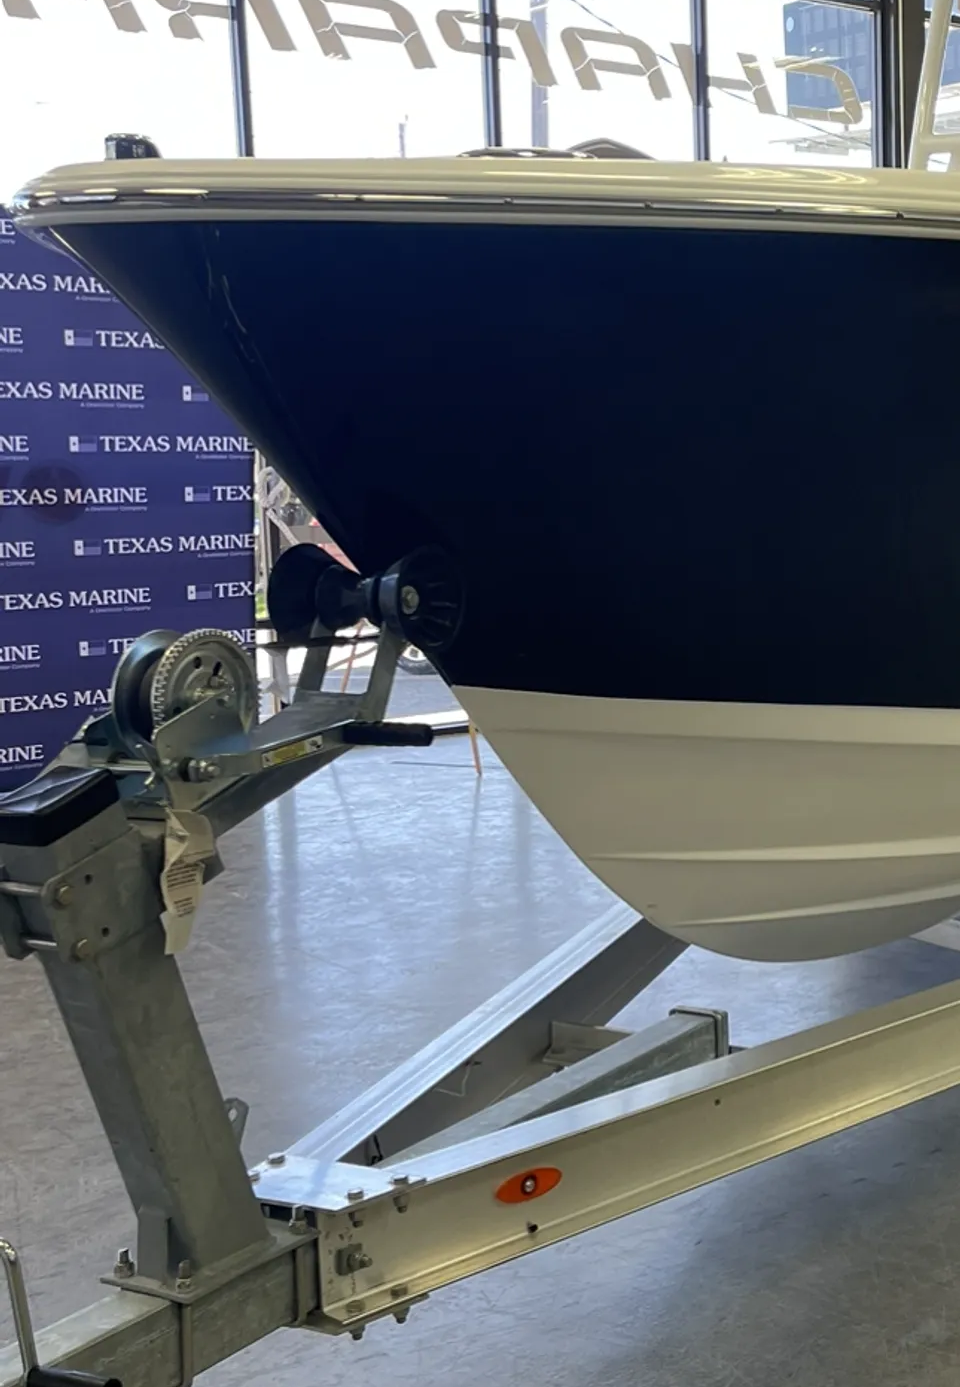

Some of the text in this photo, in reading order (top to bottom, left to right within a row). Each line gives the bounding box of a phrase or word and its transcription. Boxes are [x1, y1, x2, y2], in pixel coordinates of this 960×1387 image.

[0, 273, 111, 294] XAS MAR
[58, 382, 145, 401] MARINE
[99, 435, 255, 453] TEXAS MARINE
[63, 486, 148, 505] MARINE
[212, 485, 253, 502] TEX
[104, 536, 173, 555] TEXAS
[178, 532, 256, 552] MARINE
[68, 586, 152, 608] MARINE
[214, 580, 254, 599] TEX
[0, 692, 68, 713] TEXAS
